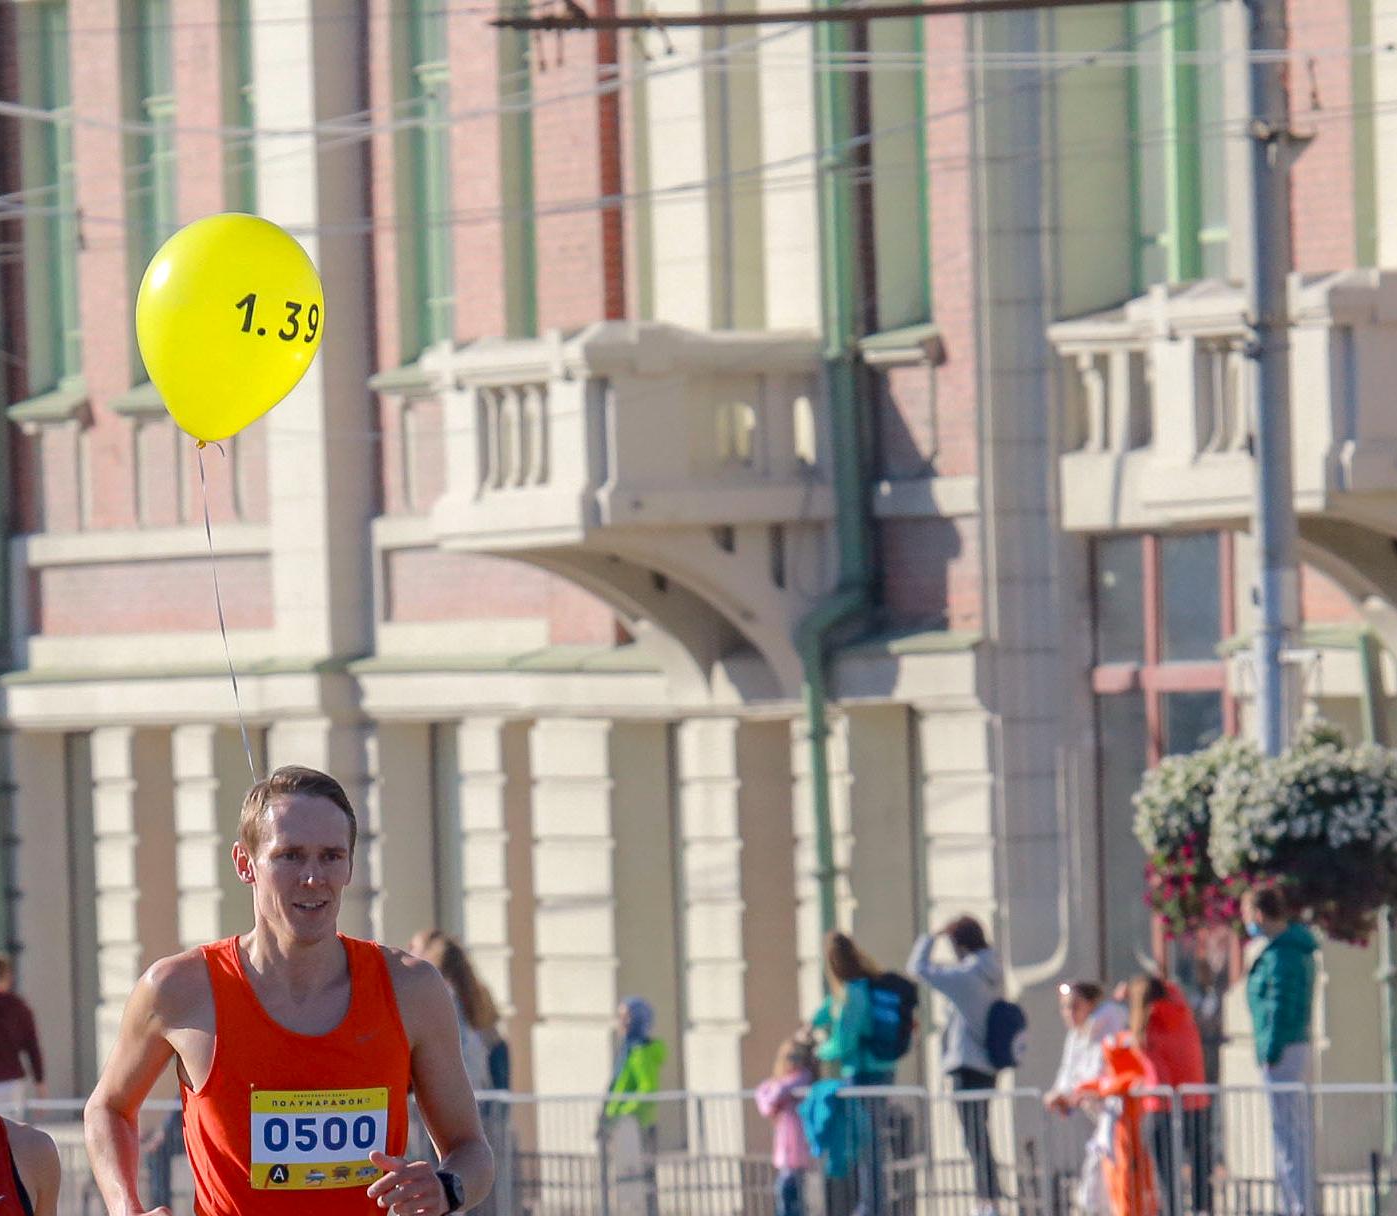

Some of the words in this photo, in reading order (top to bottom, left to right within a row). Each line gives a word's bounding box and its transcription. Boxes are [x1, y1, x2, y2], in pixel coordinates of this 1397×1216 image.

[235, 293, 319, 343] 1.39
[271, 1098, 363, 1108] ПОЛУМАРАФОН
[263, 1115, 376, 1152] 0500
